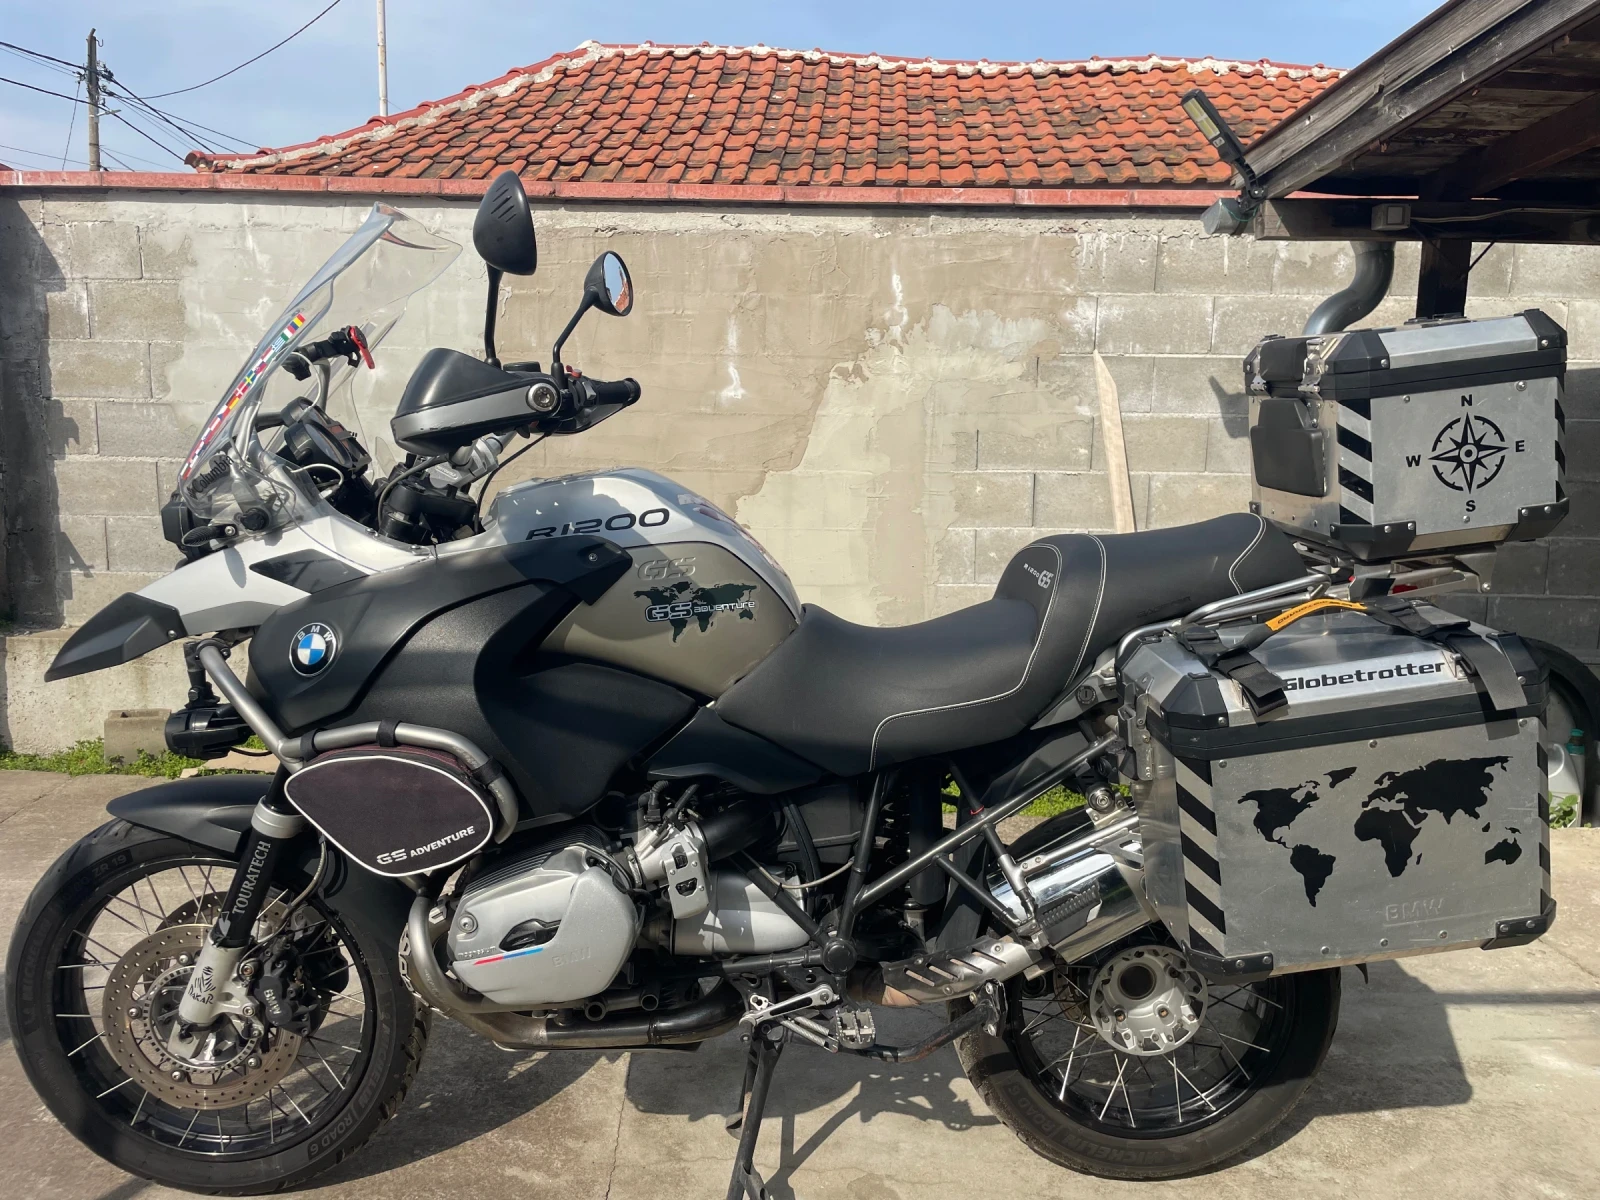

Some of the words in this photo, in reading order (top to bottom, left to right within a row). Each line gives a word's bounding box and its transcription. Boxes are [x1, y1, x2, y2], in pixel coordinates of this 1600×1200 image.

[1461, 394, 1473, 407] N
[1405, 454, 1421, 467] W
[1515, 440, 1525, 452] E
[192, 455, 235, 493] Columbia
[1465, 499, 1476, 512] S
[525, 507, 670, 540] R1200
[637, 556, 696, 580] GS
[645, 601, 693, 622] GS
[297, 625, 333, 642] BMW
[1283, 661, 1445, 691] Globetrotter
[376, 848, 407, 865] GS
[410, 825, 476, 858] ADVENTURE
[111, 854, 127, 867] 19
[232, 840, 271, 914] TOURATECH
[1385, 897, 1445, 921] BMW
[187, 983, 214, 1005] DAKAR
[263, 988, 282, 1015] BMW
[358, 1023, 391, 1109] MICHELIN
[1018, 1096, 1056, 1135] ROAD
[321, 1112, 353, 1148] ROAD
[1064, 1134, 1166, 1165] MICHELIN
